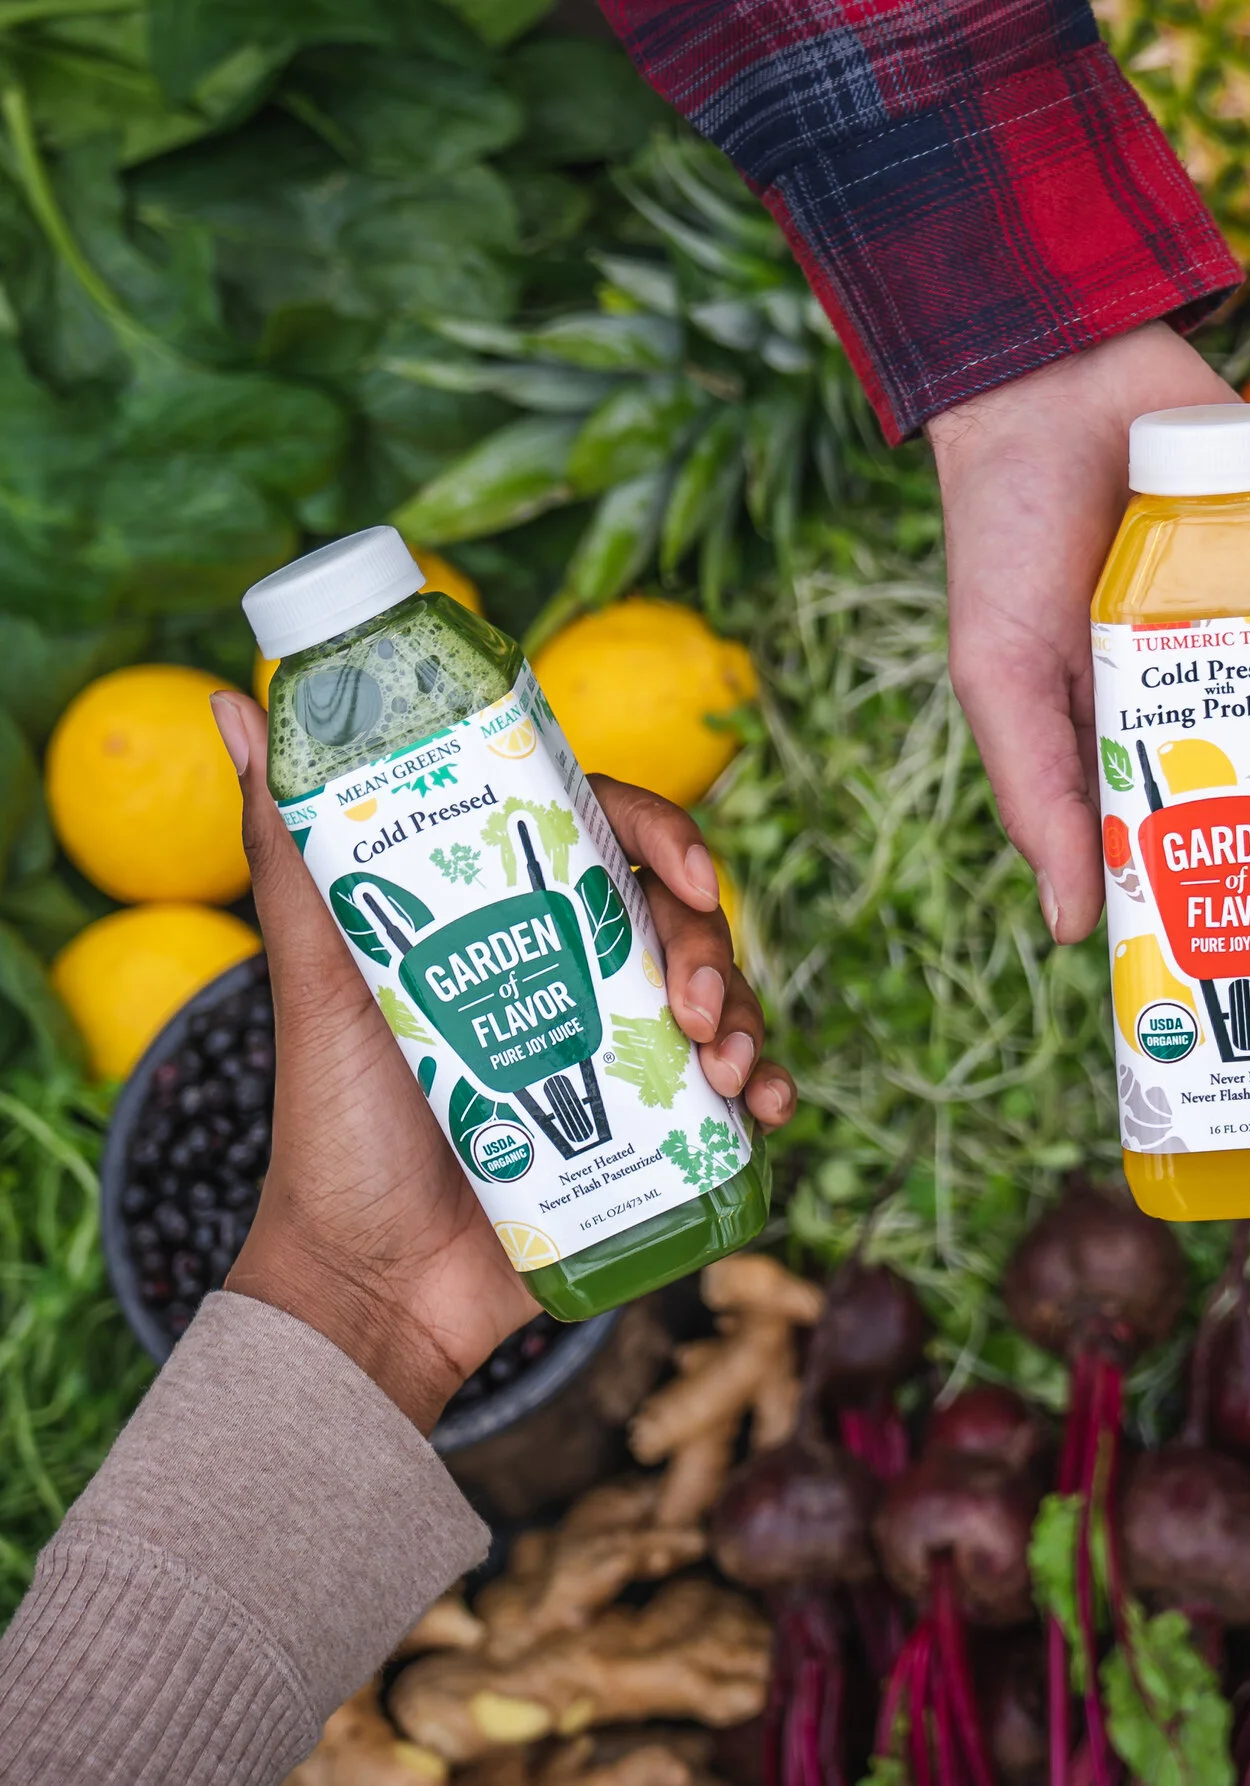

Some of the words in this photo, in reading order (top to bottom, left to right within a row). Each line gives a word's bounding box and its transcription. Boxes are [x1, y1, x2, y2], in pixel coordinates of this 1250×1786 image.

[1132, 632, 1235, 652] TURMERIC
[1141, 661, 1199, 688] Cold
[1205, 682, 1235, 695] with
[480, 704, 522, 739] MEAN
[1120, 705, 1195, 731] Living
[336, 772, 389, 806] MEAN
[392, 739, 461, 779] GREENS
[353, 820, 408, 863] Cold
[408, 784, 499, 833] Pressed
[1225, 866, 1248, 893] of
[1191, 937, 1226, 953] PURE
[1229, 935, 1250, 952] JOY
[423, 913, 562, 1004] GARDEN
[499, 971, 519, 999] of
[472, 981, 577, 1048] FLAVOR
[1150, 1018, 1183, 1030] USDA
[490, 1044, 526, 1070] PURE
[525, 1034, 548, 1056] JOY
[548, 1017, 584, 1046] JUICE
[1147, 1034, 1189, 1047] ORGANIC
[1210, 1072, 1245, 1086] Never
[1181, 1092, 1216, 1105] Never
[1220, 1088, 1250, 1102] Flash
[1209, 1125, 1221, 1135] 16
[1224, 1124, 1237, 1134] FL
[483, 1135, 516, 1156] USDA
[487, 1148, 527, 1172] ORGANIC
[558, 1166, 593, 1186] Never
[594, 1143, 636, 1171] Heated
[538, 1195, 572, 1214] Never
[572, 1179, 602, 1198] Flash
[601, 1149, 664, 1184] Pasteurized
[579, 1221, 592, 1231] 16
[593, 1215, 606, 1225] FL
[607, 1199, 643, 1219] OZ/473
[644, 1188, 661, 1202] ML
